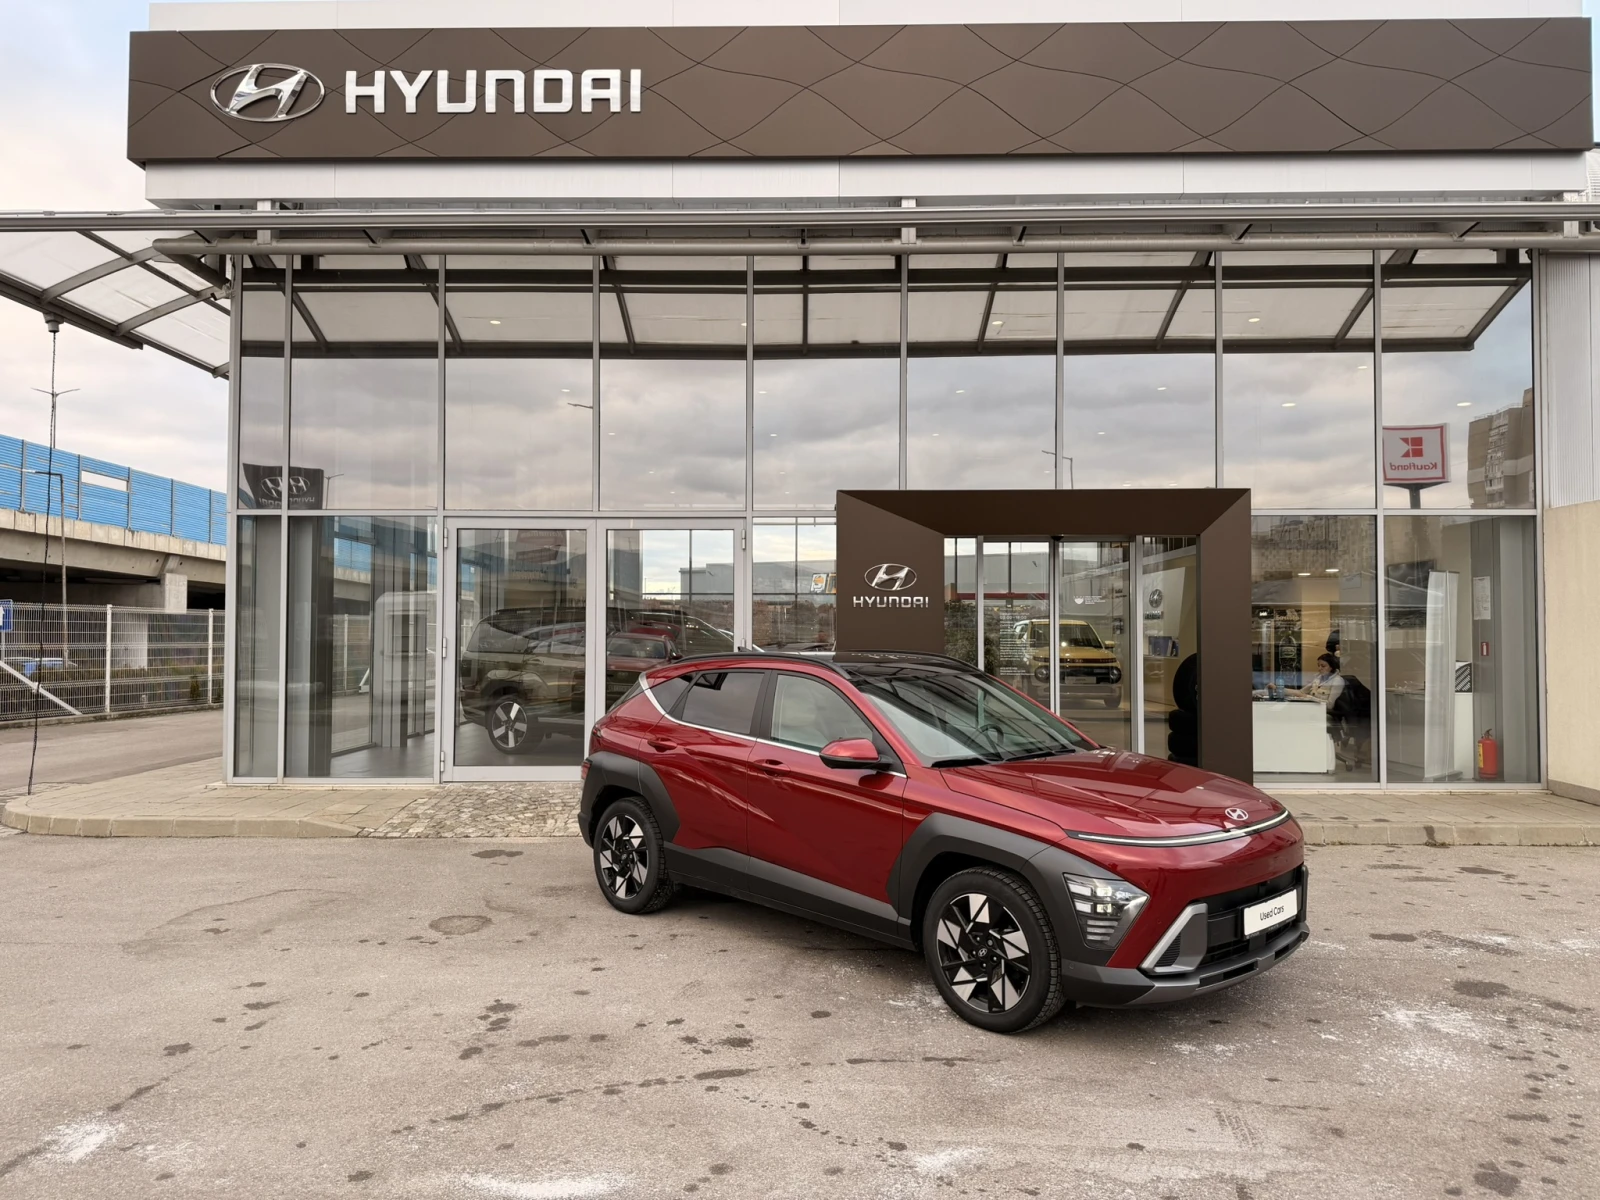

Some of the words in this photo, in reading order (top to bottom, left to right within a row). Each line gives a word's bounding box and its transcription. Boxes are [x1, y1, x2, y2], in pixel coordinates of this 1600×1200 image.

[345, 69, 642, 113] HYUNDAI
[853, 596, 929, 608] HYUNDAI
[1259, 908, 1273, 921] Used
[1273, 905, 1285, 916] Cars
